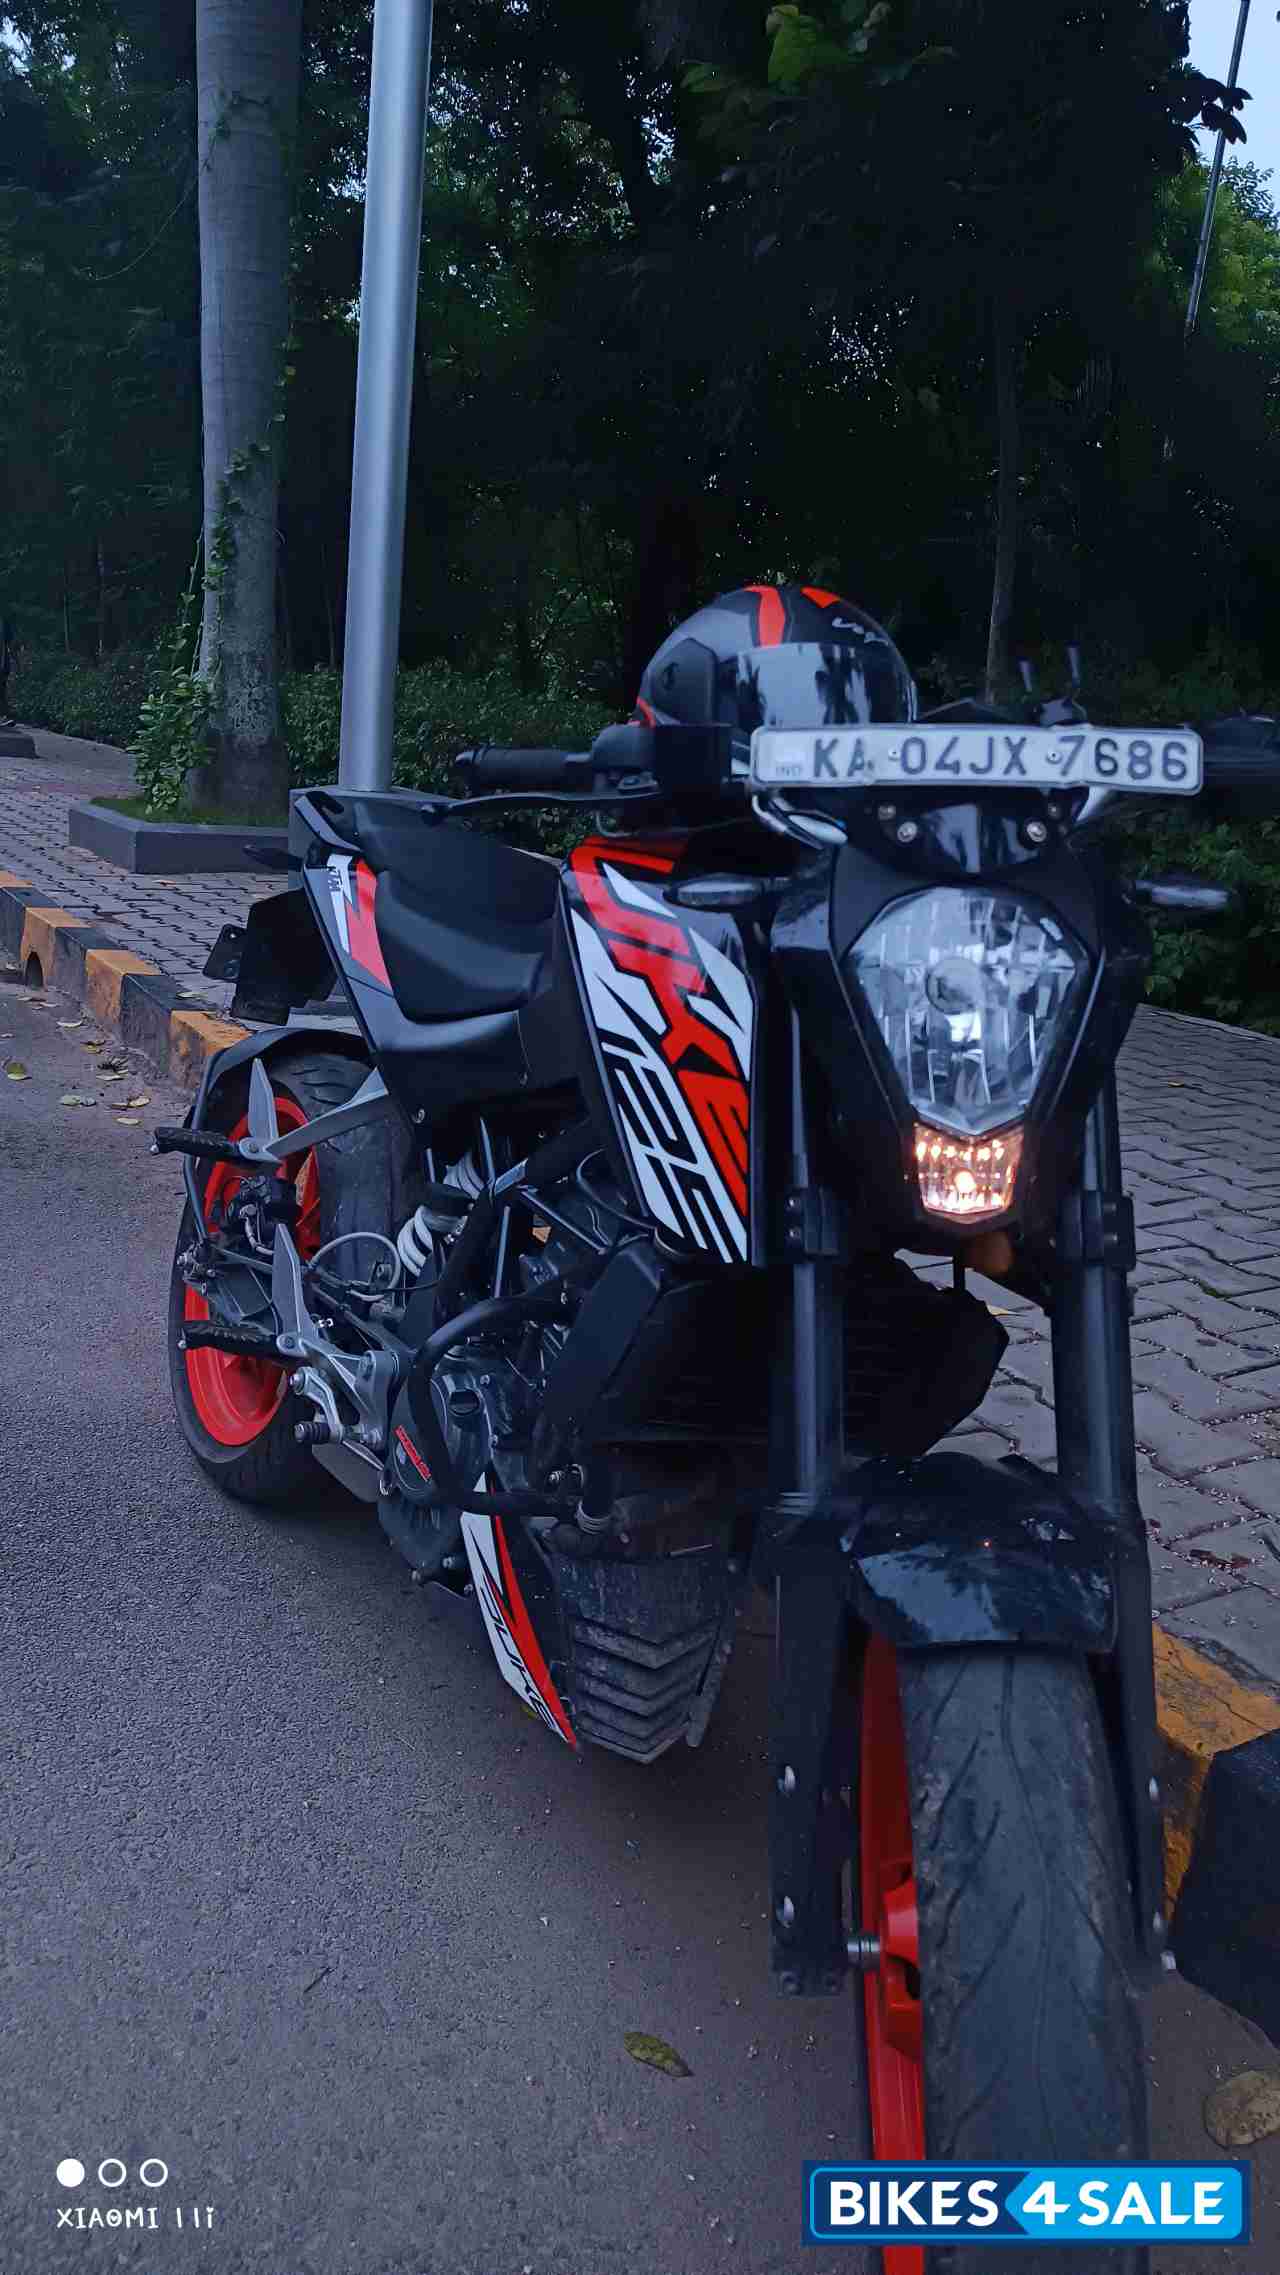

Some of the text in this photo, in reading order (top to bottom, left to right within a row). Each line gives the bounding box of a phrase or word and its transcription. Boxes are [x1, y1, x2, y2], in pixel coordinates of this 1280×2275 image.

[813, 735, 1187, 782] KA 04JX 7686
